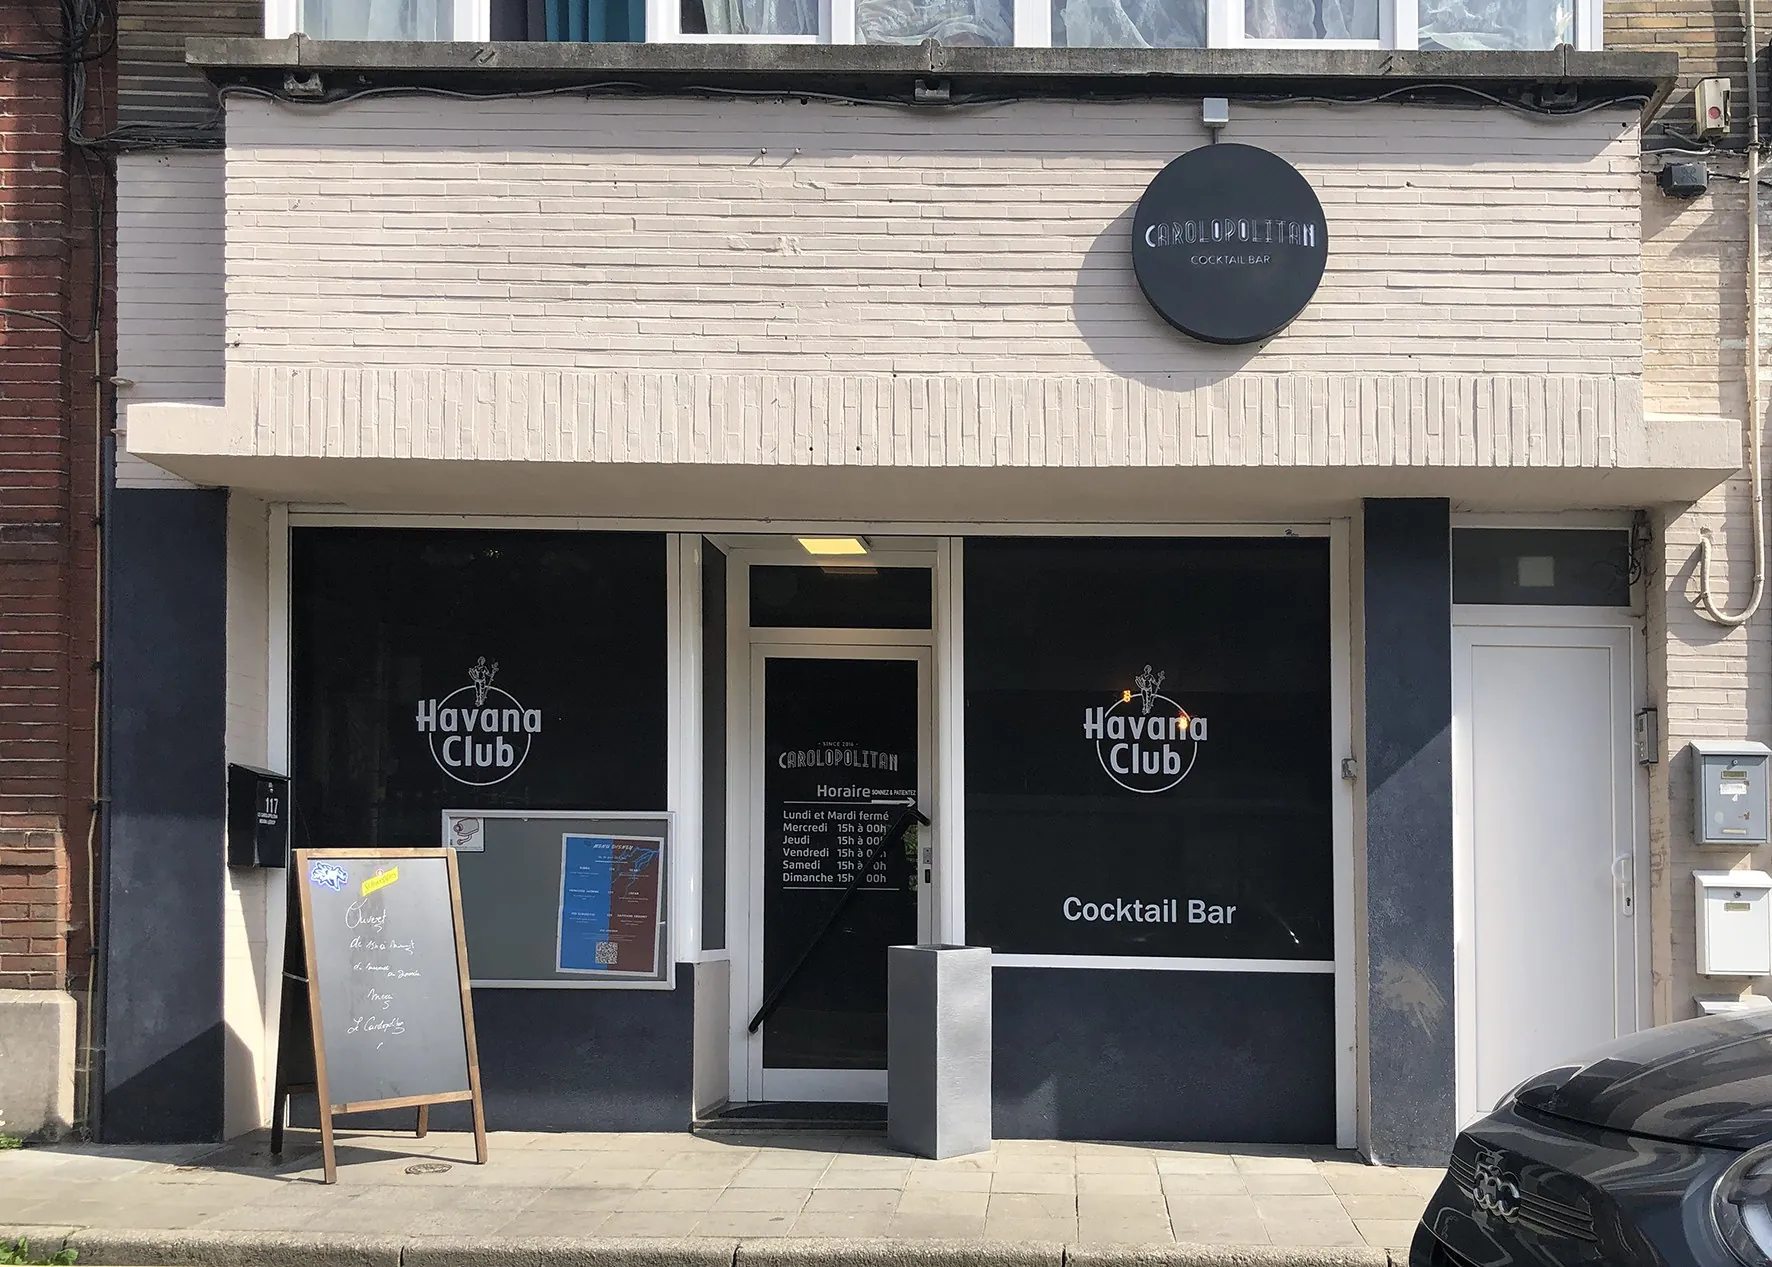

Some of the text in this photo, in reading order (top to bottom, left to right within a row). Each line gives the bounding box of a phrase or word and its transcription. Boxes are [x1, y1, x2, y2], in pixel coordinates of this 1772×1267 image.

[1145, 218, 1316, 248] CAROLOPOLITAN
[1190, 255, 1271, 265] COCKTAIL BAR
[416, 699, 542, 733] Havana
[1083, 707, 1208, 741] Havana
[442, 735, 514, 767] Club
[778, 749, 898, 771] CAROLOPOLITAN
[1110, 743, 1181, 775] Club
[817, 784, 871, 798] Horaire
[266, 797, 279, 814] 117
[783, 810, 889, 821] Lundi et Mardi fermé
[783, 823, 887, 834] Mercredi 15h à 00h
[783, 835, 810, 845] Jeudi
[837, 836, 855, 846] 15h
[857, 835, 864, 845] à
[783, 848, 830, 857] Vendredi
[837, 848, 855, 858] 15h
[857, 848, 864, 858] à
[783, 860, 821, 870] Samedi
[837, 861, 855, 871] 15h
[783, 872, 887, 883] Dimanche 15h 00h
[1063, 896, 1237, 924] Cocktail Bar
